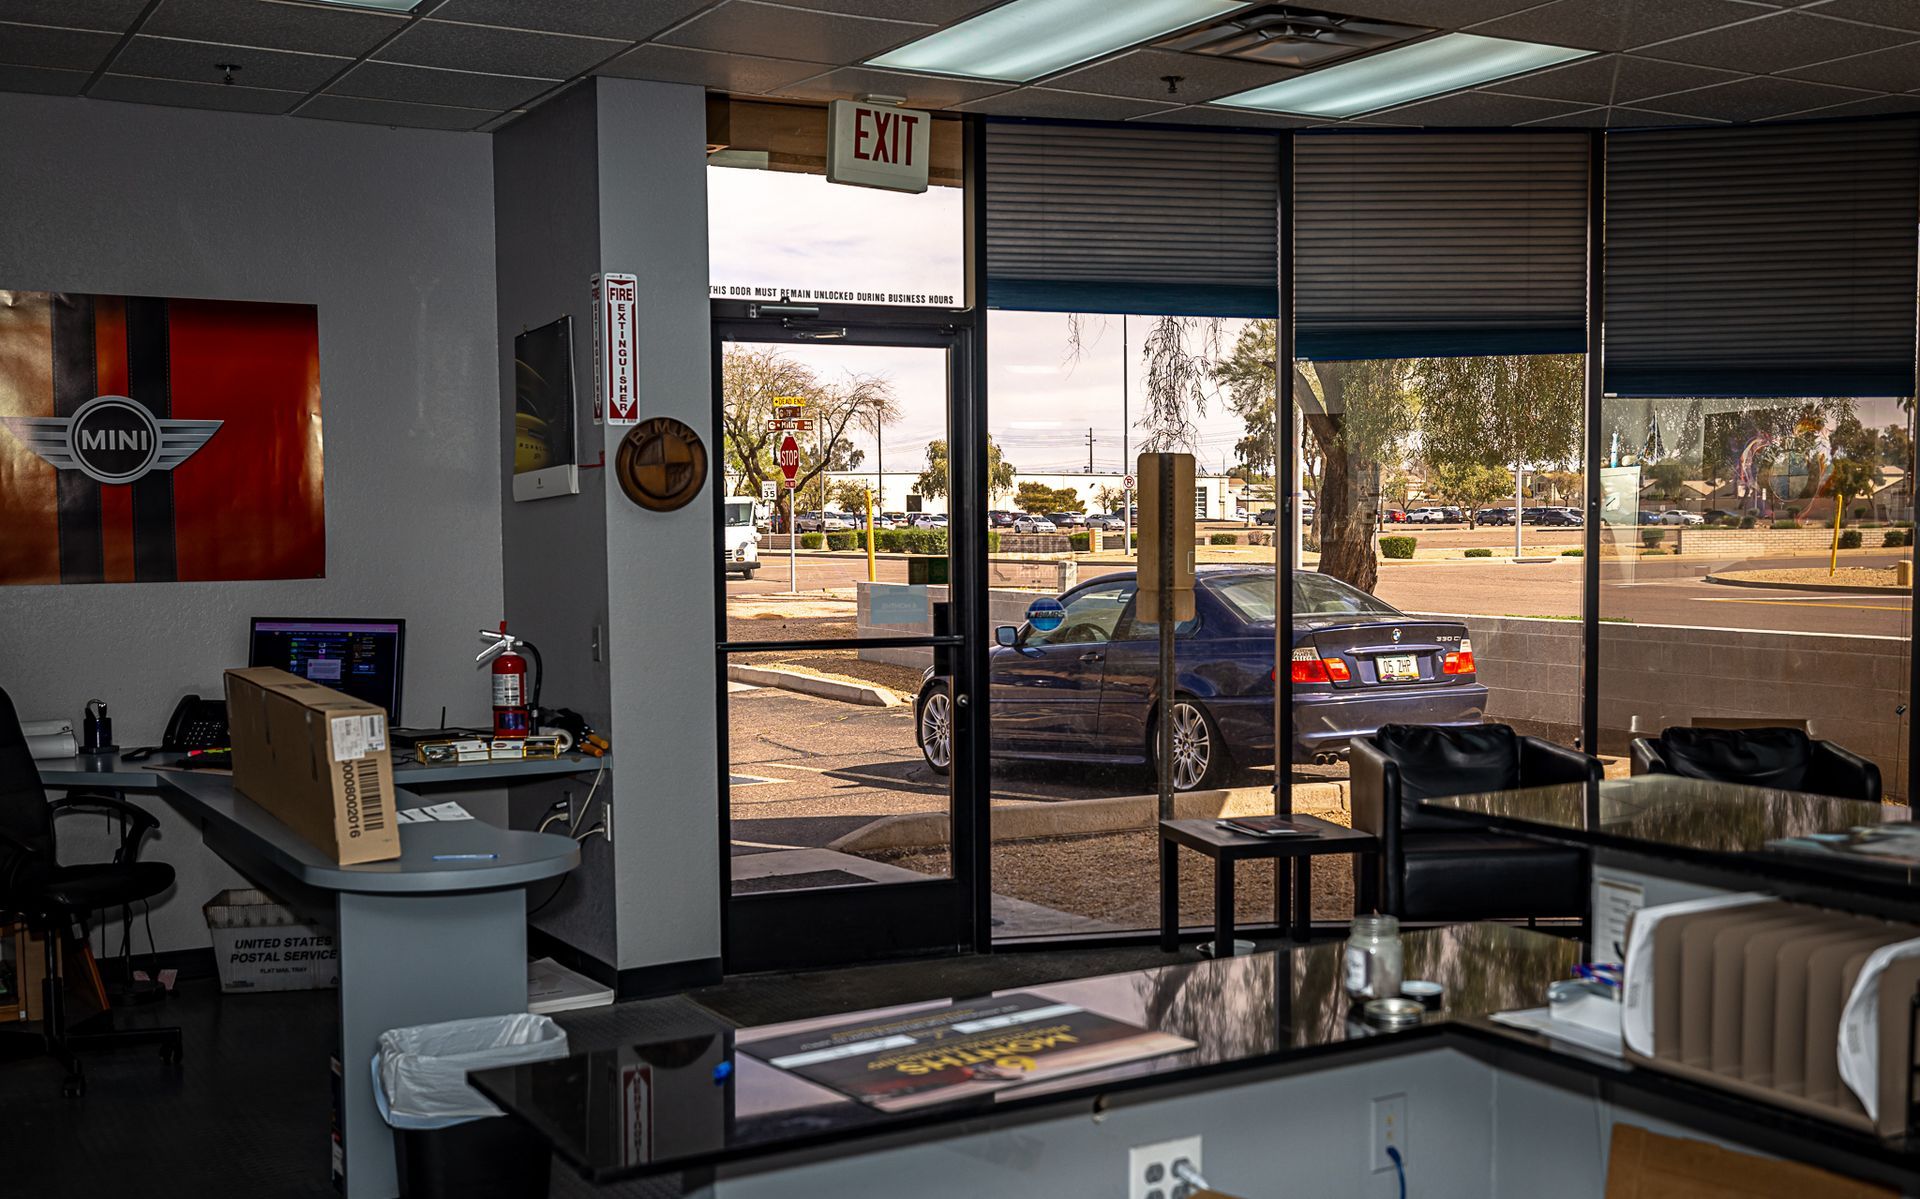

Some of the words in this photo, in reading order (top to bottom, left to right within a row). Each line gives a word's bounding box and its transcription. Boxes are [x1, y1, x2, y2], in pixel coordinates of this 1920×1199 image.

[854, 108, 919, 166] EXIT
[609, 287, 633, 302] FIRE
[709, 285, 727, 295] THIS
[730, 286, 751, 296] DOOR
[755, 287, 777, 297] MUST
[780, 289, 811, 299] REMAIN
[814, 290, 854, 301] UNLOCKED
[857, 292, 885, 302] DURING
[888, 293, 926, 304] BUSINESS
[929, 294, 954, 305] HOURS
[617, 303, 628, 411] EXTINGUISHER
[628, 419, 698, 446] BMW
[781, 420, 798, 430] Milky
[81, 429, 148, 451] MINI
[781, 450, 798, 466] STOP
[763, 490, 775, 498] 35
[1383, 660, 1394, 673] 05
[1397, 659, 1411, 673] ZHP
[235, 938, 281, 950] UNITED
[283, 936, 332, 948] STATES
[230, 952, 280, 964] POSTAL
[283, 949, 337, 961] SERVICE
[896, 1030, 1079, 1075] MONTHS
[995, 1055, 1038, 1071] 6
